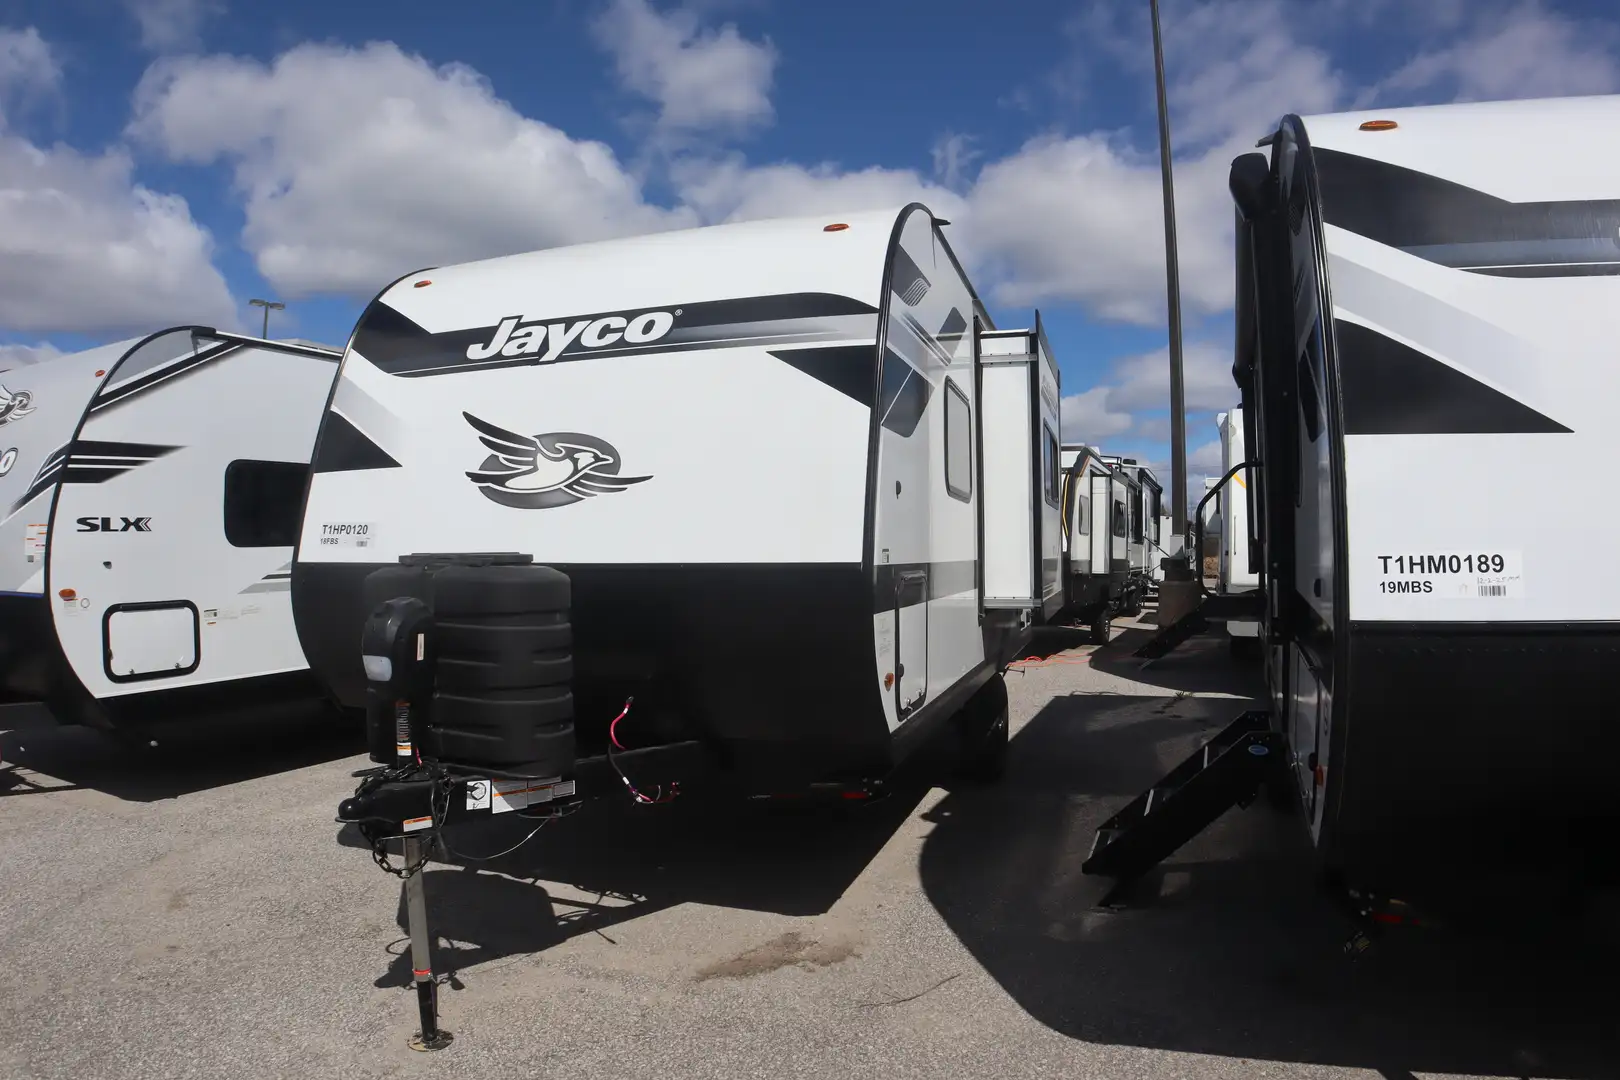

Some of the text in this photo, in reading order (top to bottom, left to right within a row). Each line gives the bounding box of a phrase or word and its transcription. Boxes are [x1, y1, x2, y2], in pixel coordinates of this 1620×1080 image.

[76, 516, 152, 532] SLX
[322, 524, 369, 535] T1HP0120
[1377, 554, 1505, 574] T1HM0189
[1379, 580, 1433, 594] 19MBS
